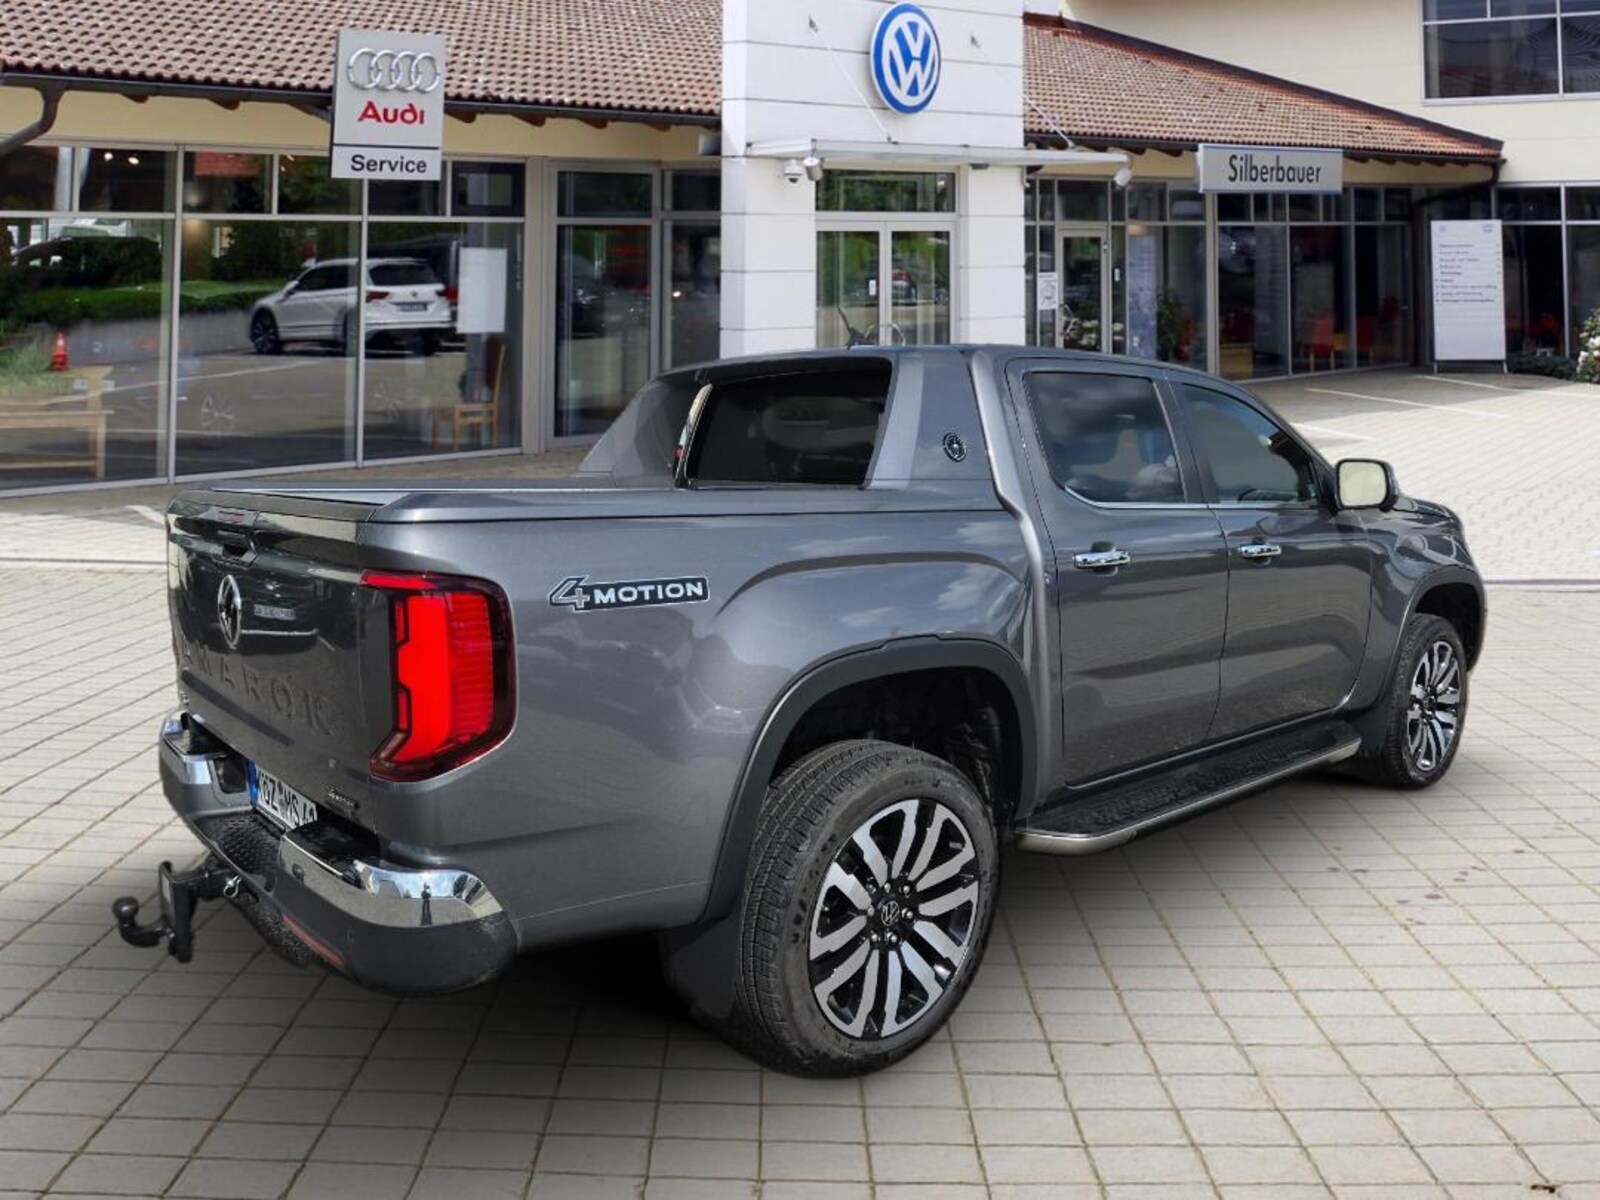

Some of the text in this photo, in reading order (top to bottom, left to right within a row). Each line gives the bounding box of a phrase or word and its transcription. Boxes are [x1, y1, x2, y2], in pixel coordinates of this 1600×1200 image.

[357, 100, 425, 125] Audi
[350, 154, 428, 174] Service
[1228, 153, 1322, 184] Silberbauer
